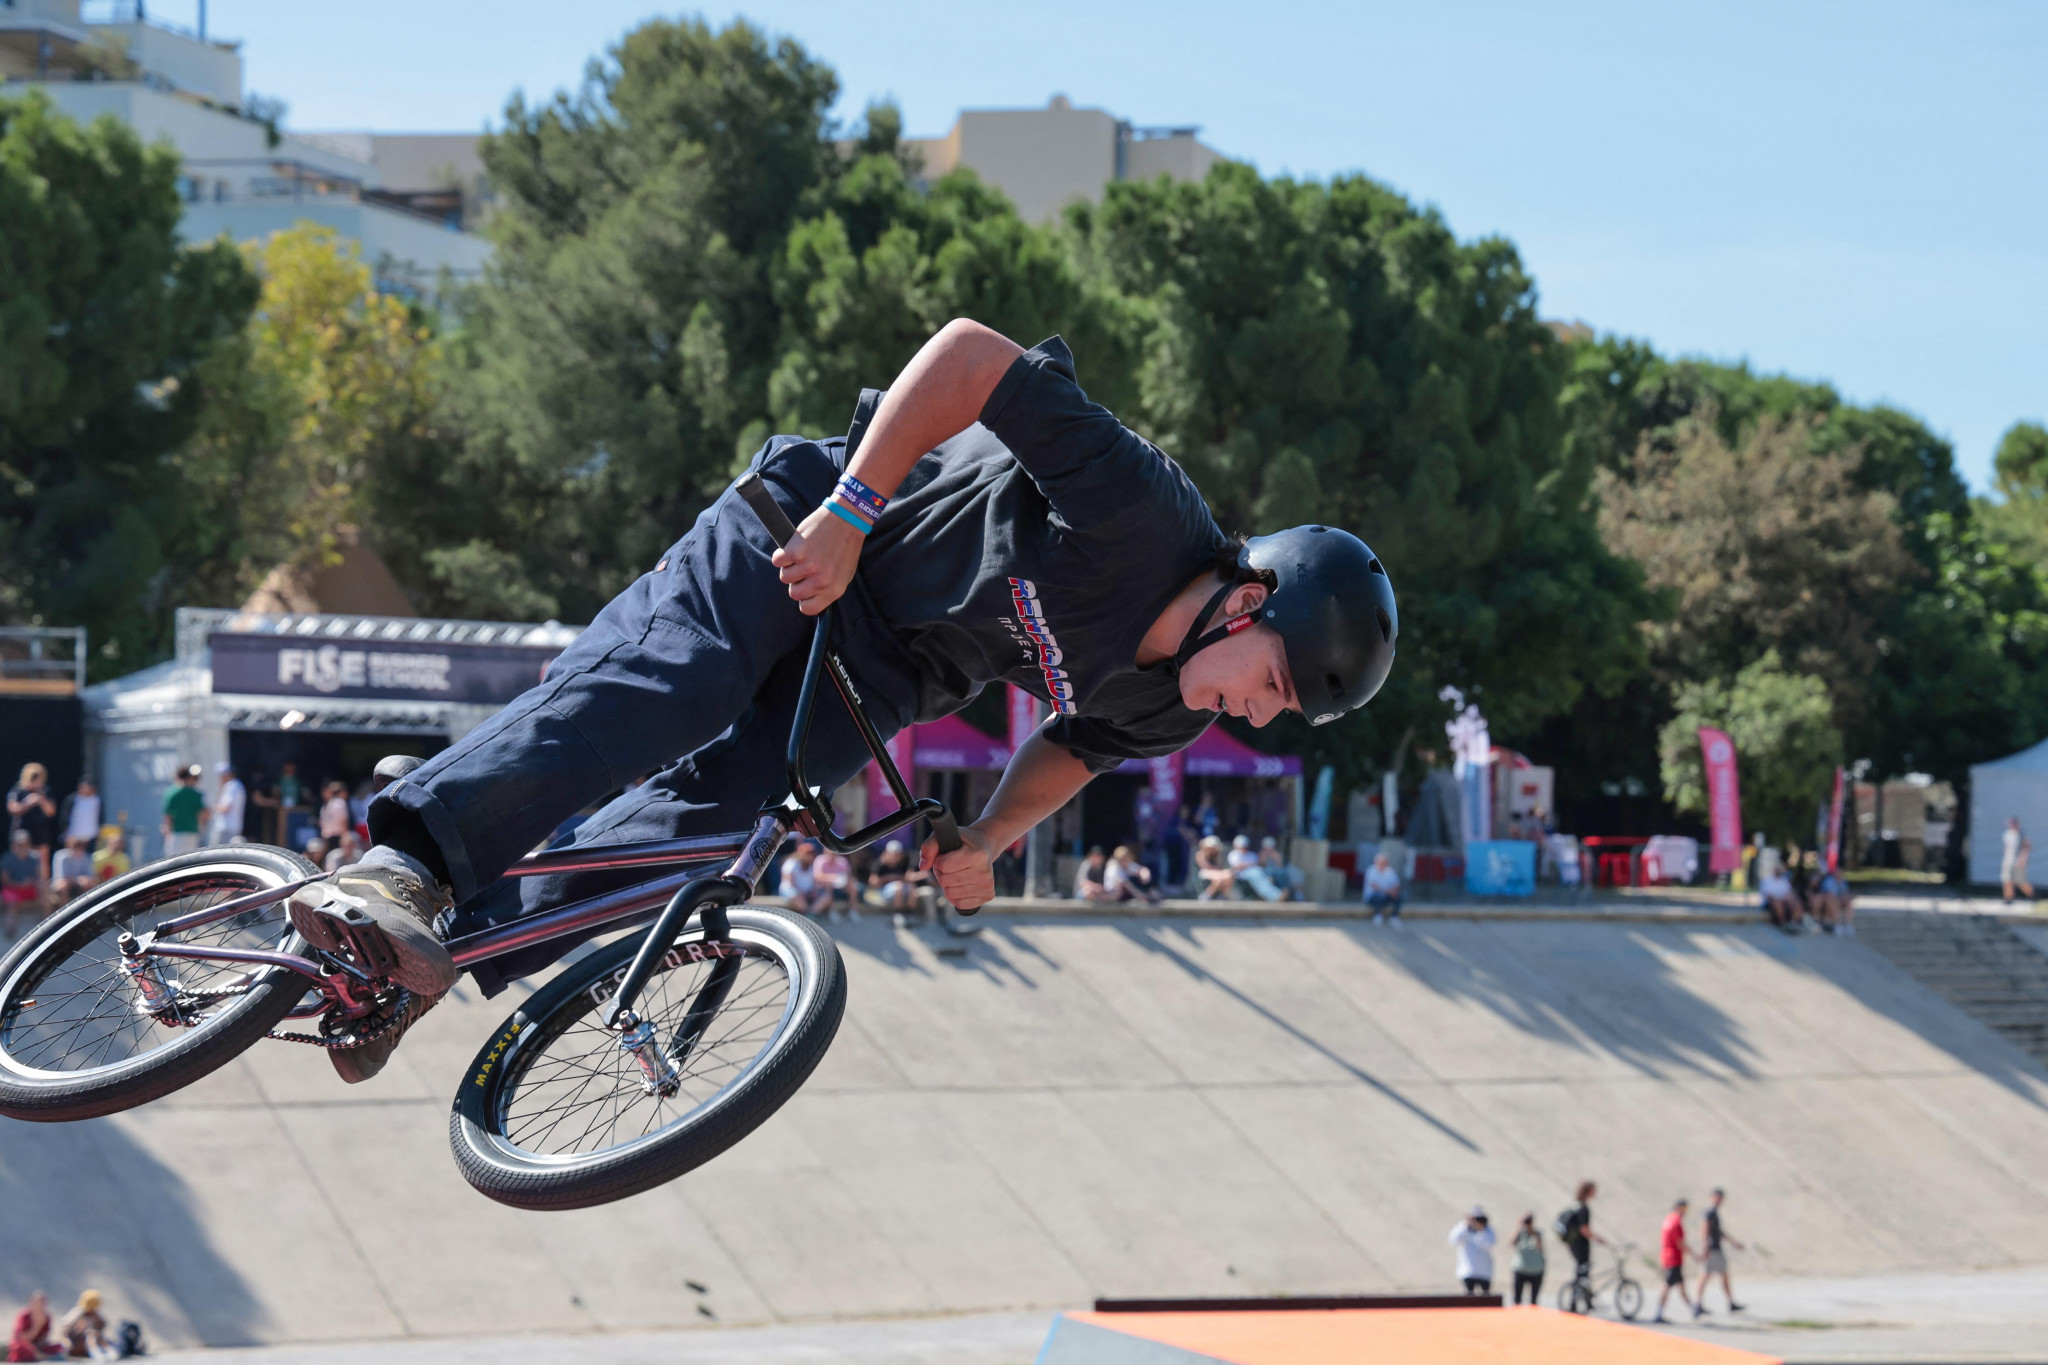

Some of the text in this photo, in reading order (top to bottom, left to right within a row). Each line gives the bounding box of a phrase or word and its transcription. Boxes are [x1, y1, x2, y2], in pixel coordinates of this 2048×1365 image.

[279, 645, 366, 692] FISE
[1007, 577, 1078, 715] RENEGADE
[475, 1023, 521, 1087] MAXXIS
